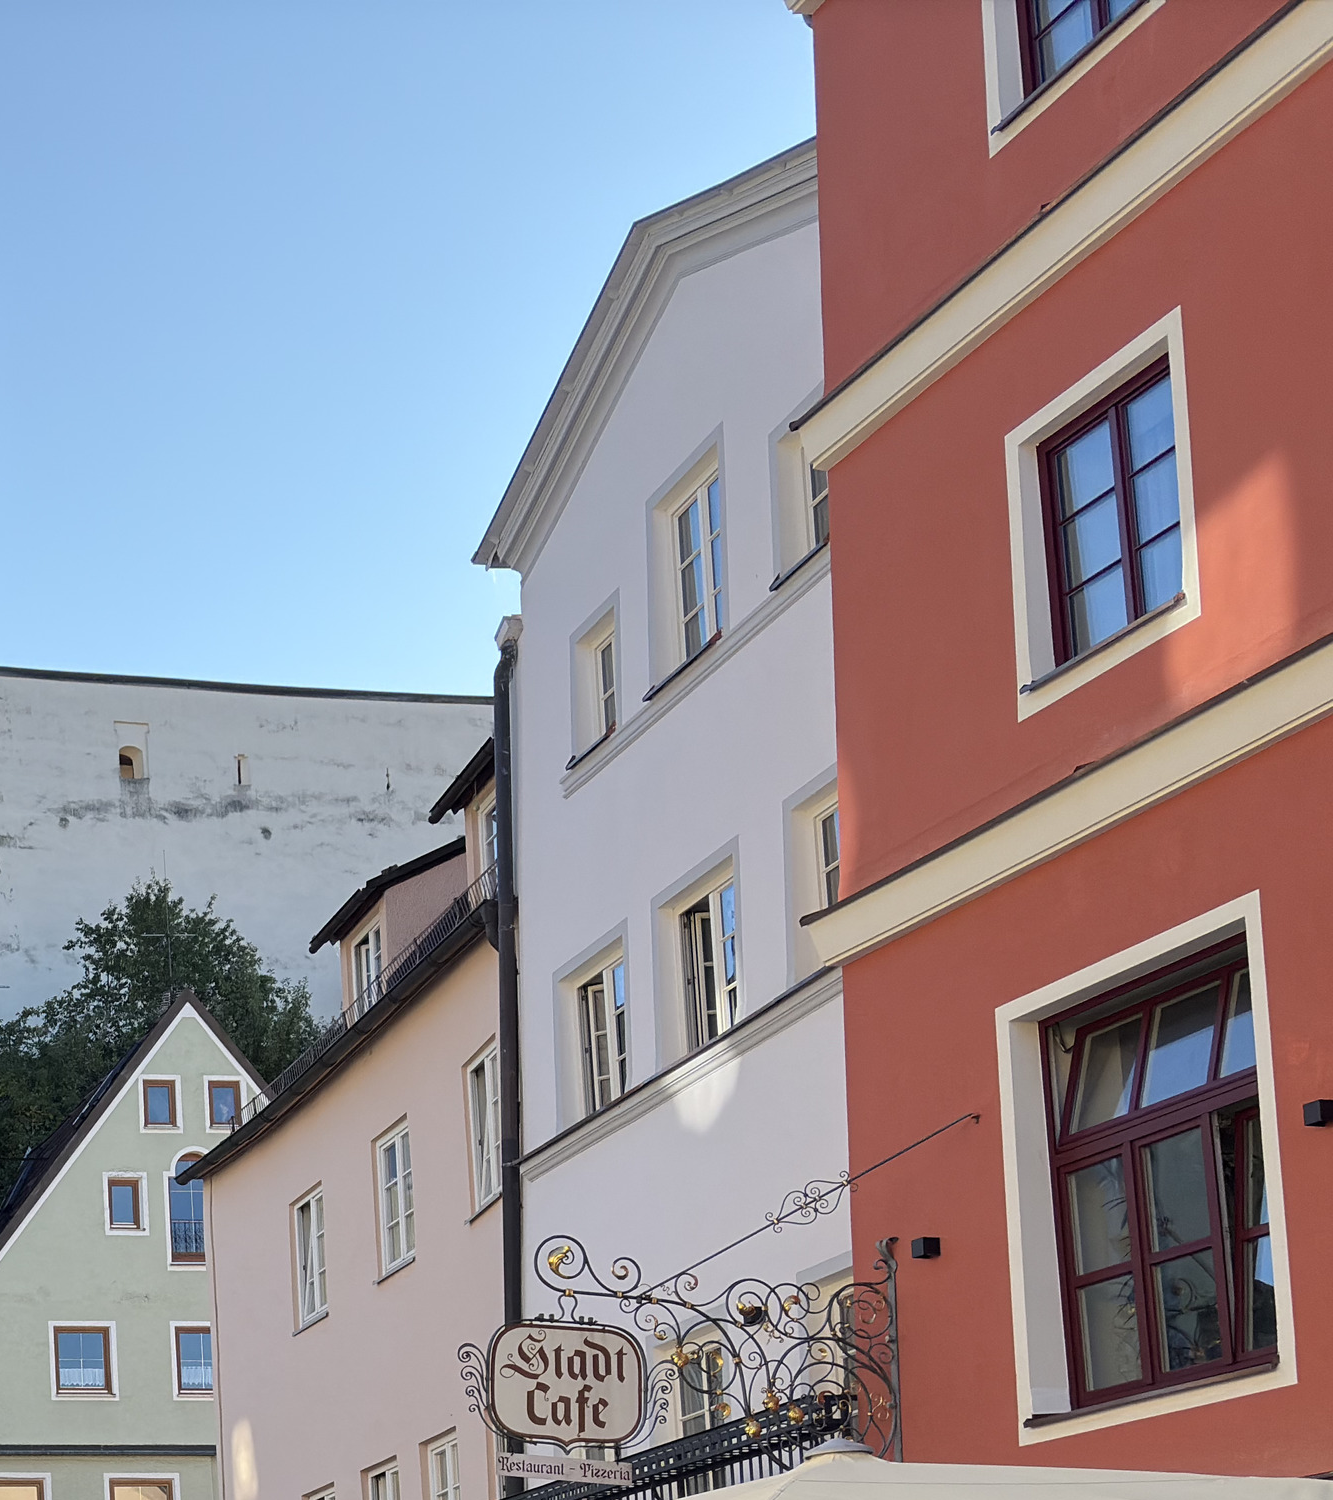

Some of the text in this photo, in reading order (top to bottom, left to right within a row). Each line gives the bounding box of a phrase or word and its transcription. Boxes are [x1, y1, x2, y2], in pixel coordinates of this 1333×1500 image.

[499, 1329, 628, 1383] Stadt
[526, 1381, 609, 1437] Cafe
[498, 1456, 564, 1476] Restaurant
[580, 1463, 631, 1481] Pizzeria
